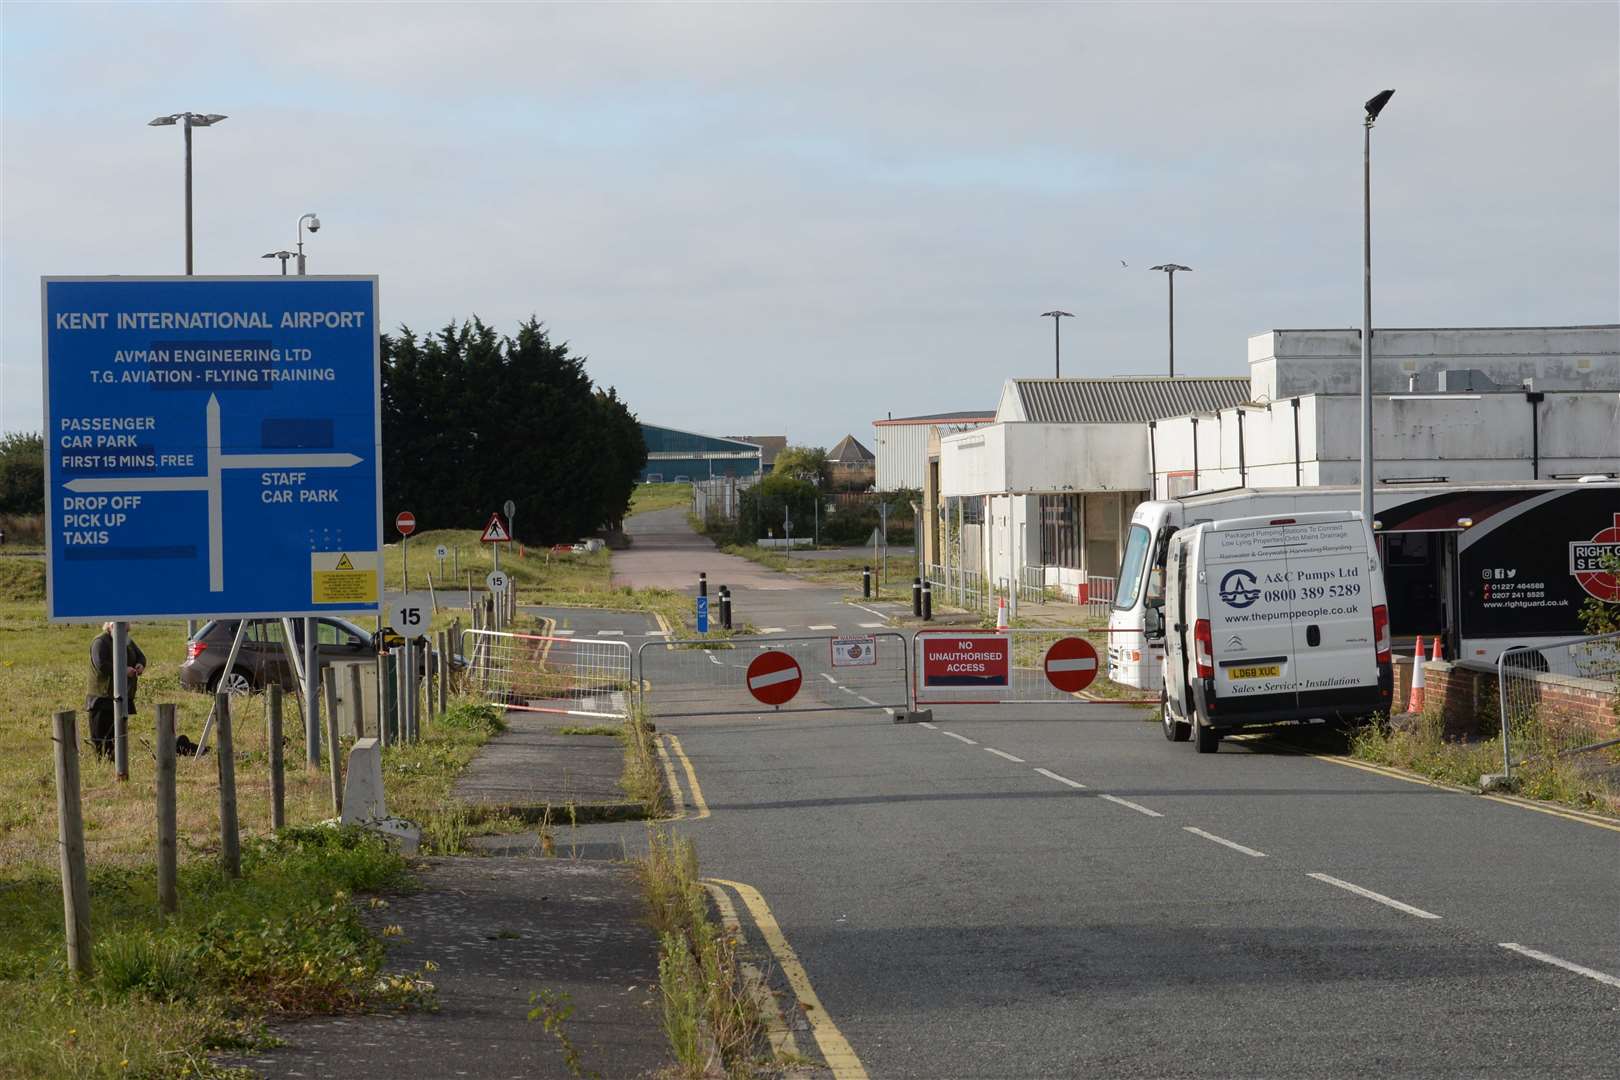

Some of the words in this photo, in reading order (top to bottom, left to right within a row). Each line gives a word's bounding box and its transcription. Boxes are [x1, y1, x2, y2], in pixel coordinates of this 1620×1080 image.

[56, 312, 109, 330] KENT
[117, 312, 272, 329] INTERNATIONAL
[281, 311, 365, 328] AIRPORT
[114, 350, 170, 364] AVMAN
[174, 350, 280, 363] ENGINEERING
[285, 349, 312, 362] LTD
[91, 370, 118, 384] T.G.
[121, 370, 192, 384] AVIATION
[205, 370, 258, 383] FLYING
[262, 369, 335, 382] TRAINING
[61, 418, 155, 430] PASSENGER
[61, 436, 93, 448] CAR
[97, 436, 137, 448] PARK
[62, 456, 100, 468] FIRST
[102, 456, 116, 467] 15
[161, 455, 194, 466] FREE
[262, 473, 306, 485] STAFF
[64, 497, 108, 509] DROP
[111, 496, 141, 509] OFF
[262, 491, 293, 503] CAR
[300, 490, 338, 502] PARK
[64, 514, 101, 527] PICK
[105, 514, 126, 526] UP
[64, 532, 109, 544] TAXIS
[1576, 546, 1612, 557] RIGHT
[493, 578, 502, 586] 15
[1264, 573, 1294, 584] A&C
[1297, 571, 1335, 582] Pumps
[1339, 567, 1359, 578] Ltd
[1264, 590, 1297, 603] 0800
[1300, 587, 1325, 600] 389
[1329, 583, 1361, 597] 5289
[1483, 600, 1569, 608] www.rightguard.co.uk
[400, 608, 421, 625] 15
[1225, 605, 1358, 623] www.thepumppeople.co.uk
[959, 641, 973, 650] NO
[929, 652, 1003, 662] UNAUTHORISED
[947, 663, 985, 673] ACCESS
[1233, 668, 1256, 679] LD68
[1258, 666, 1276, 677] XUC
[1232, 683, 1255, 694] Sales
[1264, 681, 1297, 692] Service
[1305, 677, 1360, 688] Installations
